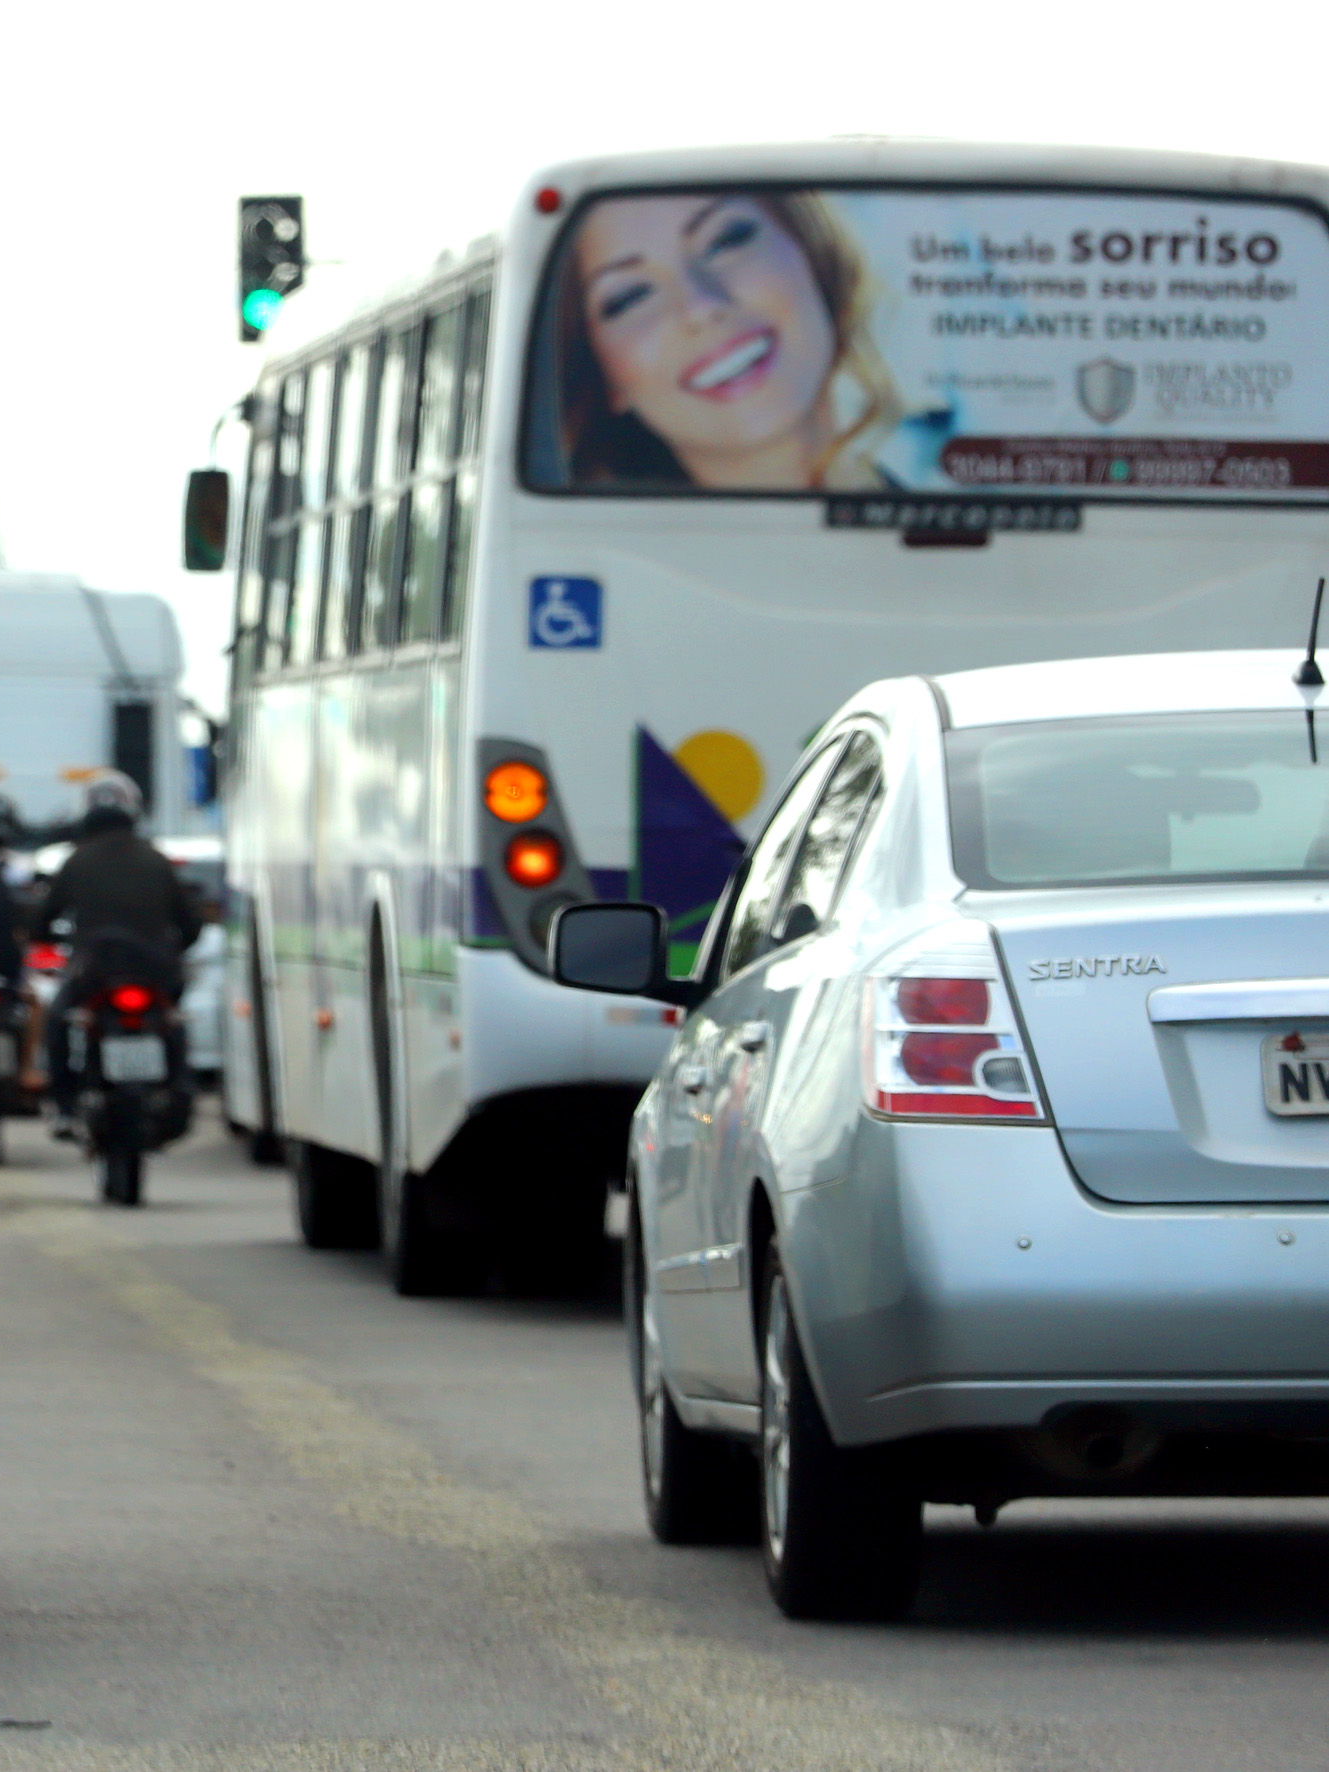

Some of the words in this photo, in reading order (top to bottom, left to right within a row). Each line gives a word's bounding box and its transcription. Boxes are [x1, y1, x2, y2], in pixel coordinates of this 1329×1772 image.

[910, 234, 969, 264] Um
[978, 232, 1057, 265] belo
[1071, 215, 1280, 267] sorriso
[1100, 274, 1156, 299] seu
[932, 311, 1092, 340] IMPLANTE
[1104, 308, 1267, 343] DENTÁRIO
[1028, 953, 1167, 981] SENTRA
